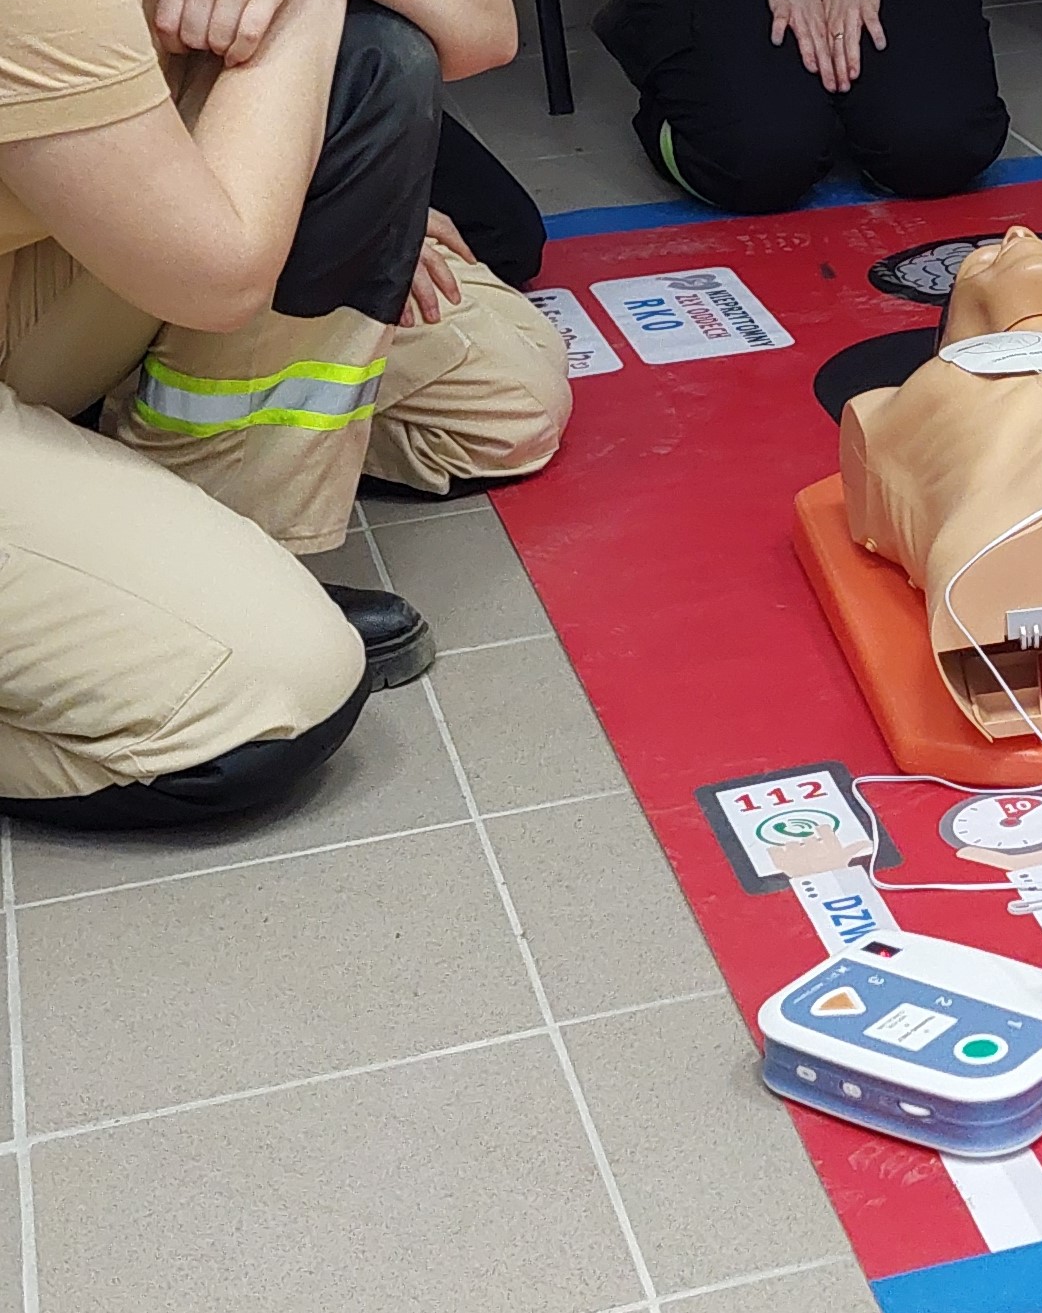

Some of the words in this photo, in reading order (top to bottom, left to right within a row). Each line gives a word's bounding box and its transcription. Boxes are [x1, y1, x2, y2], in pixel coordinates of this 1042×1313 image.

[624, 297, 684, 331] RKO
[686, 307, 732, 340] ODDECH
[705, 289, 775, 347] NIEPRZYTOMNY
[735, 780, 828, 813] 112
[1004, 801, 1032, 815] 10
[868, 975, 885, 986] 3
[935, 995, 953, 1008] 2
